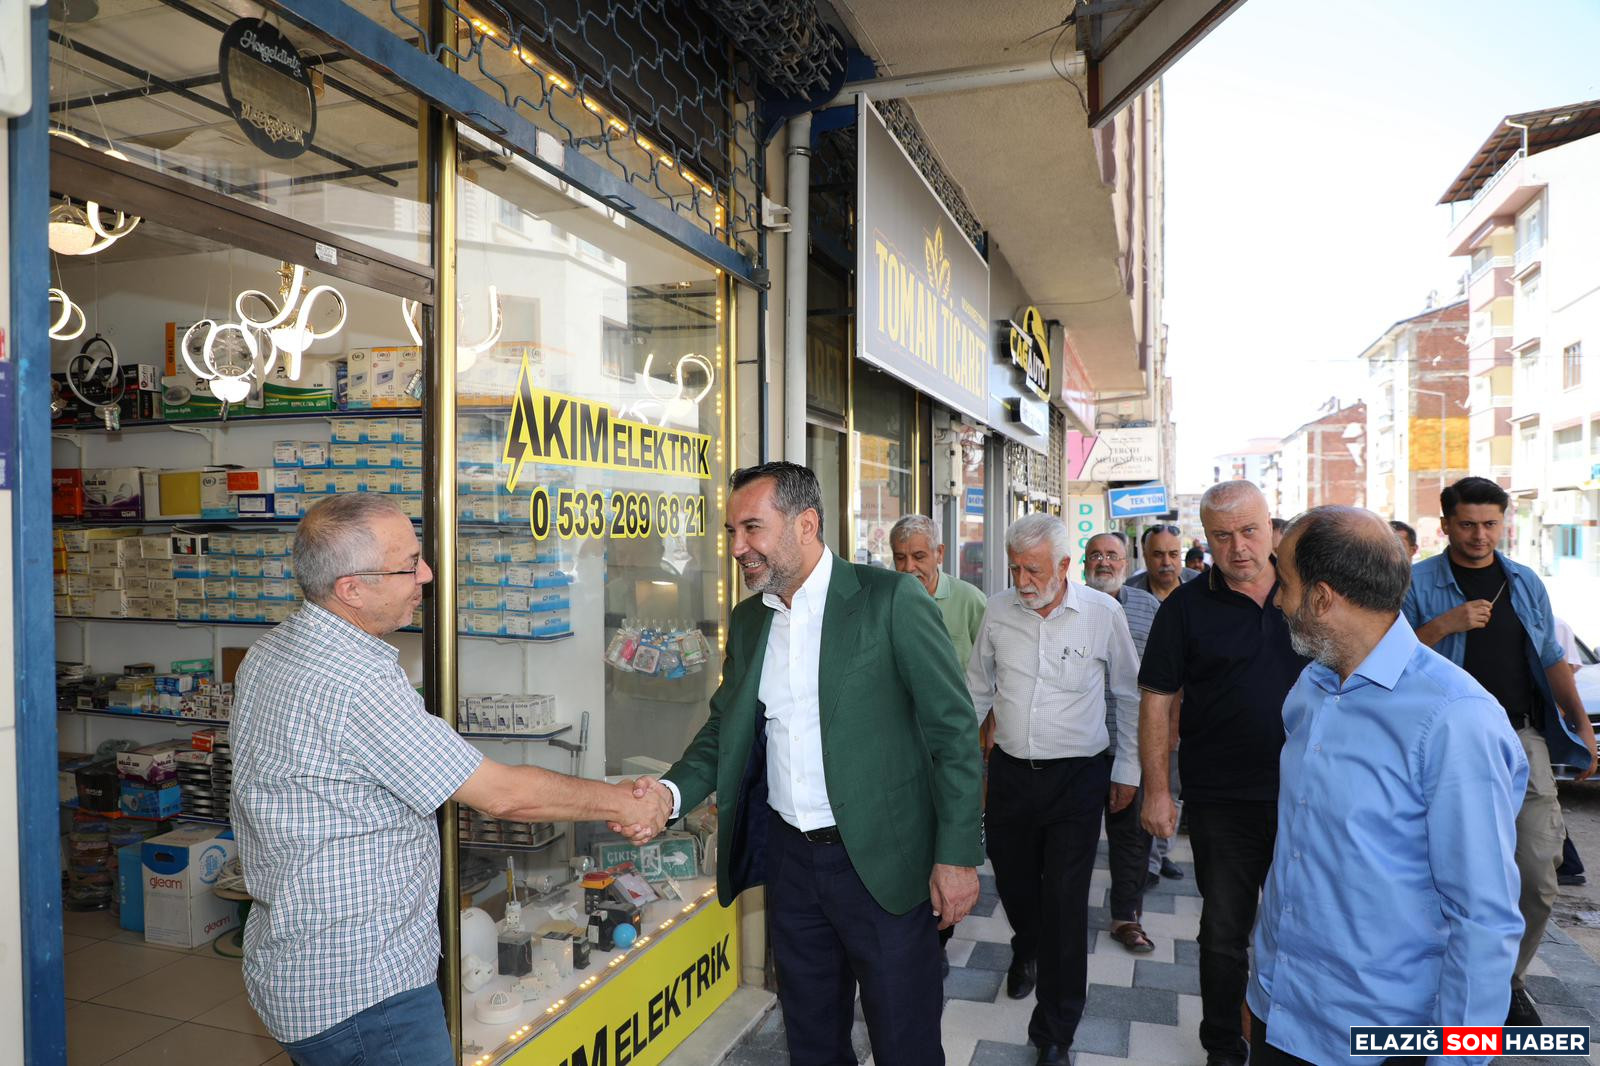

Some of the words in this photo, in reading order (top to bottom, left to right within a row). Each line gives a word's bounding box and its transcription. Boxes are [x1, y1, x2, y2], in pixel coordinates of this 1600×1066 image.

[875, 239, 938, 370] TOMAN
[1027, 347, 1046, 390] AUTO
[507, 362, 609, 485] AKIM
[530, 487, 551, 541] 0
[558, 488, 606, 540] 533
[610, 490, 653, 538] 269
[656, 495, 681, 537] 68
[684, 495, 706, 537] 21
[1130, 497, 1145, 505] TEK
[149, 876, 182, 889] gleam
[203, 915, 231, 934] gleam
